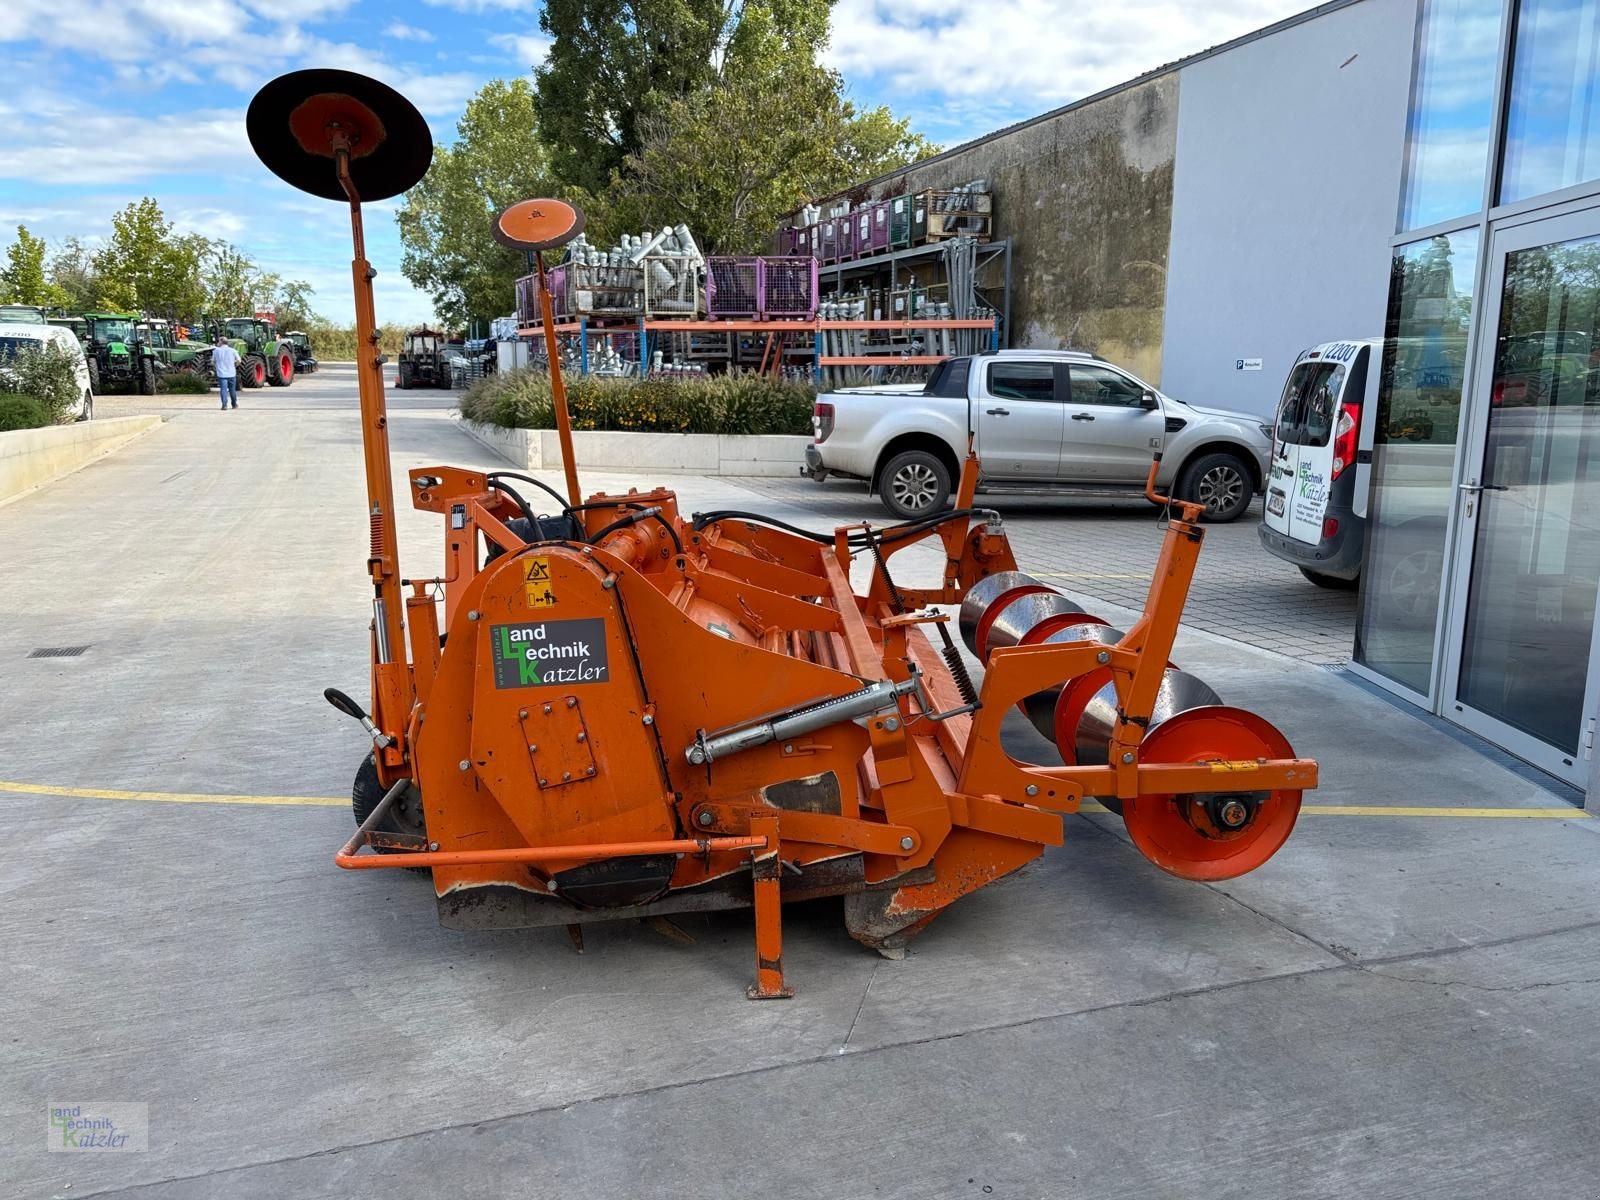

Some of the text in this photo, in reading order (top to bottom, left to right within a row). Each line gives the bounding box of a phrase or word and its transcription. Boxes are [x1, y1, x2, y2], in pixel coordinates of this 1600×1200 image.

[1325, 343, 1357, 362] 2200
[1237, 360, 1243, 369] P
[1302, 469, 1324, 484] Technik
[501, 624, 546, 658] Land
[511, 641, 590, 660] Technik
[519, 659, 606, 685] Katzler
